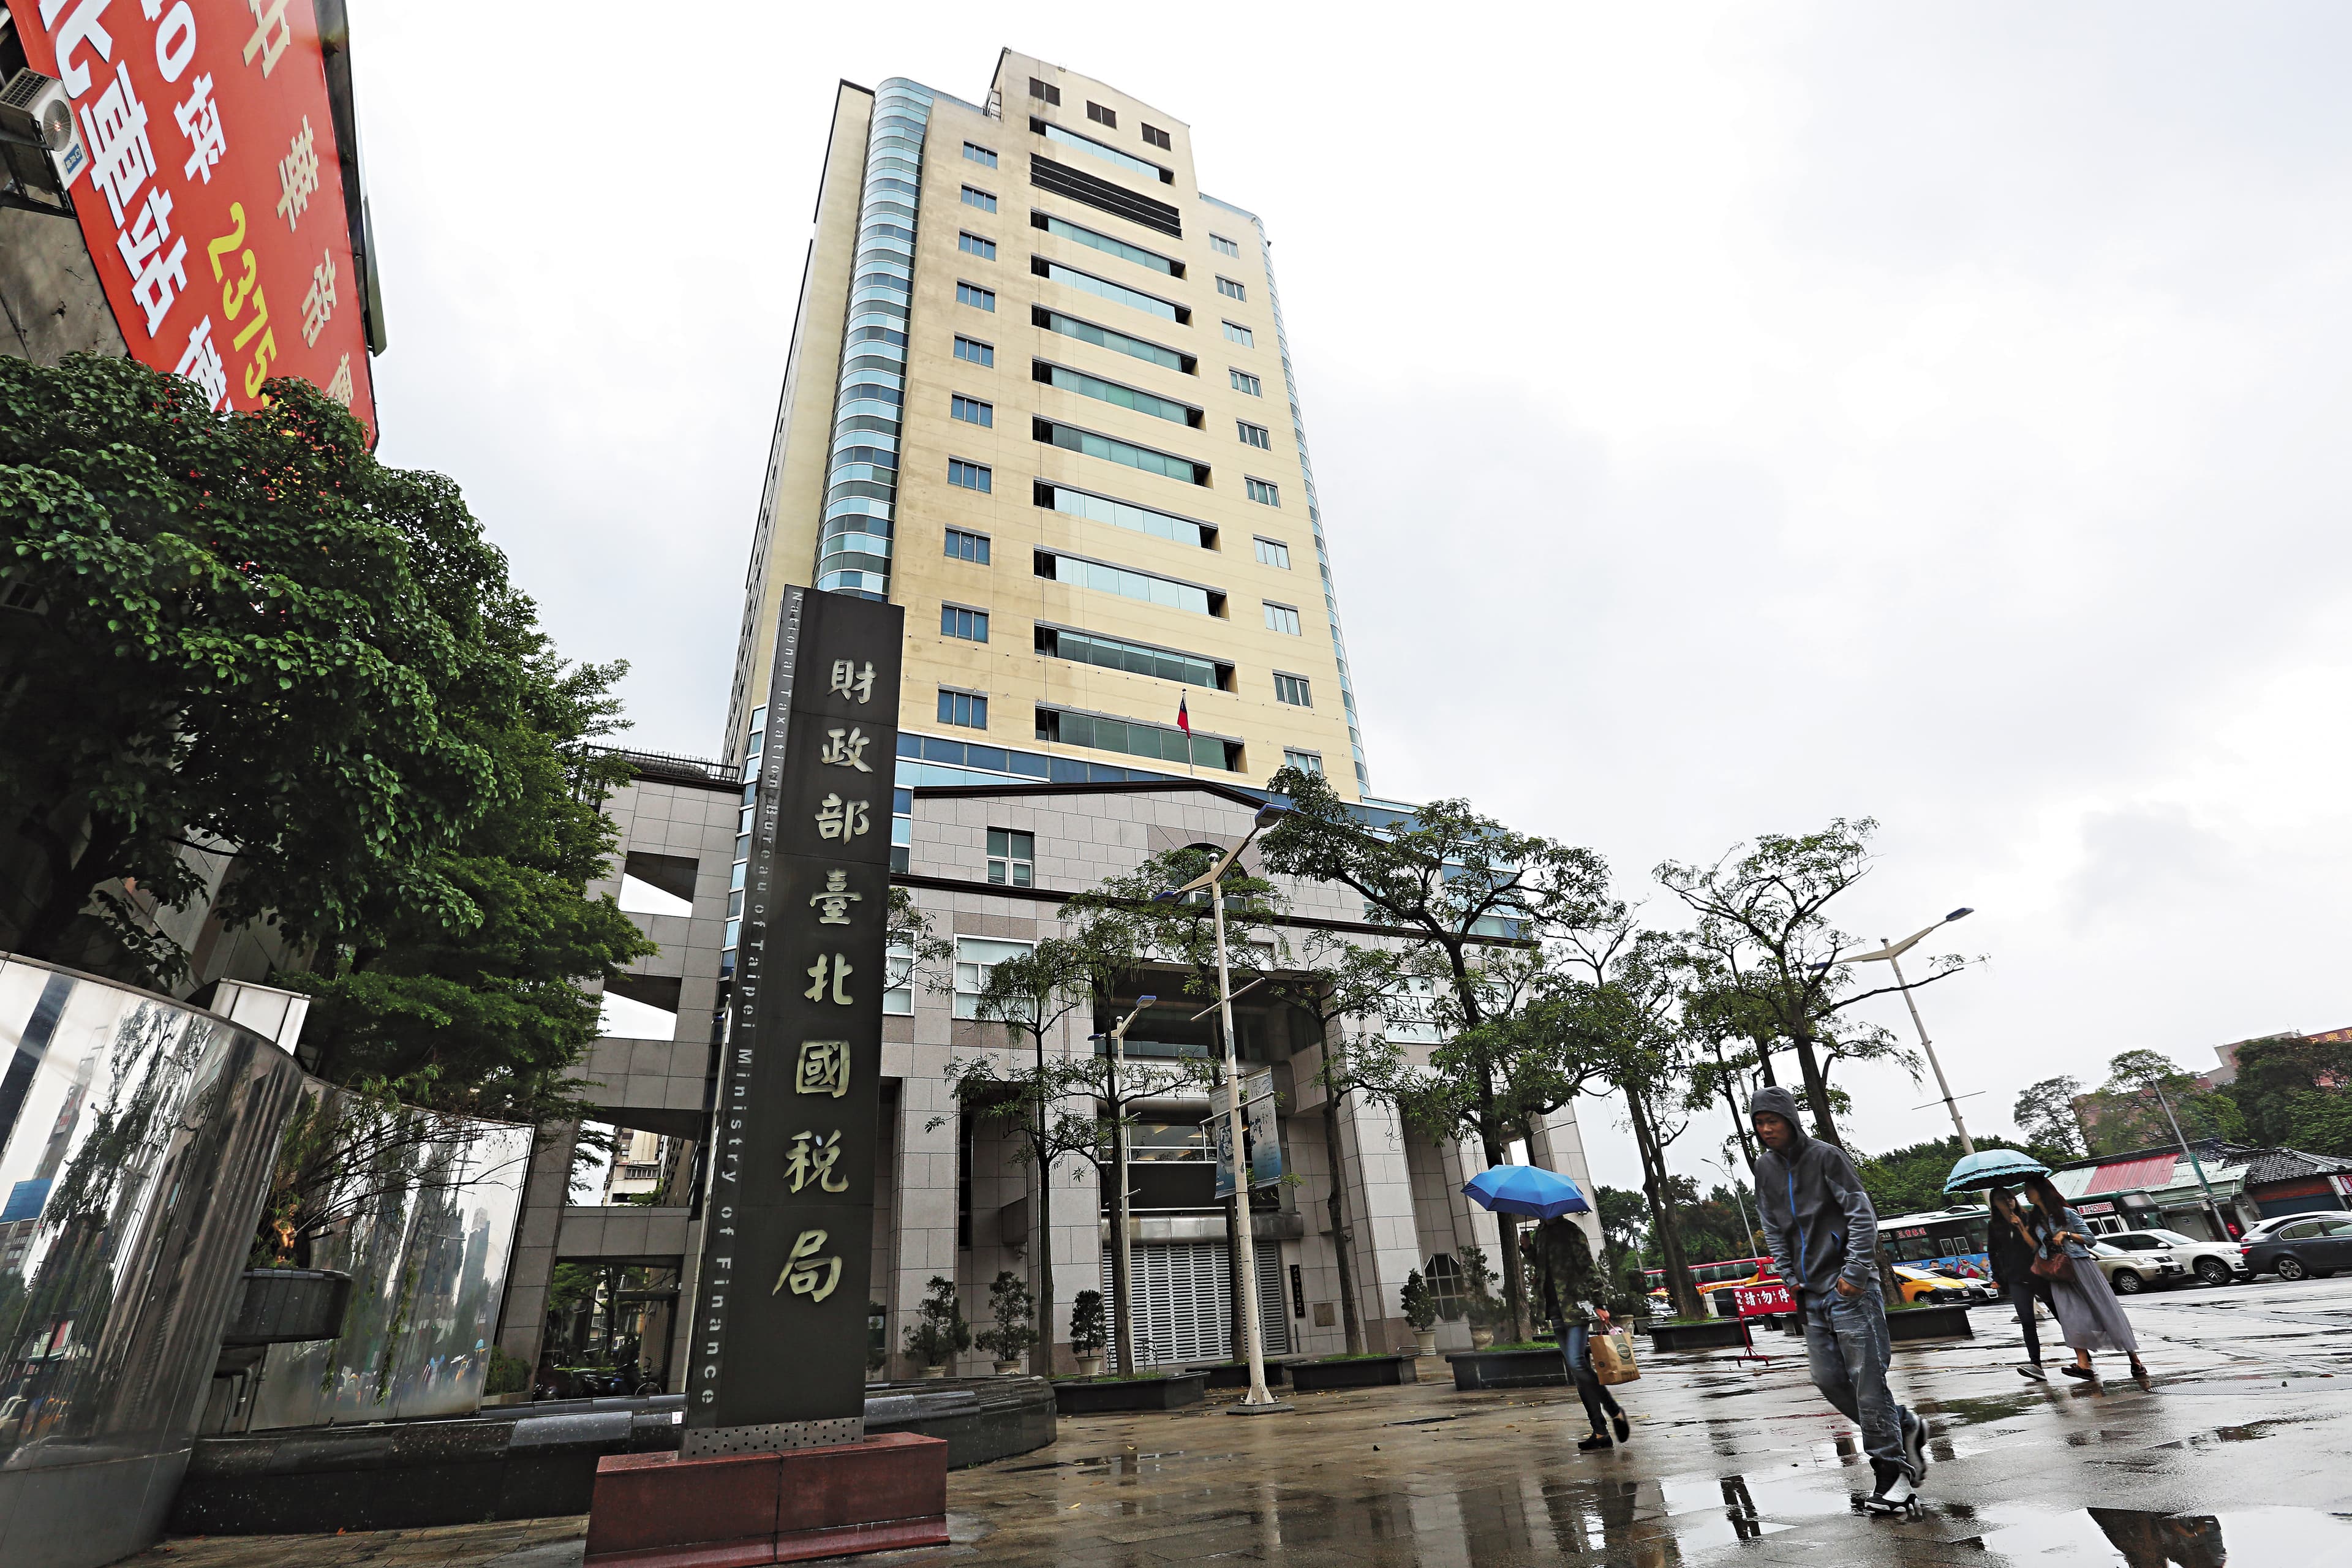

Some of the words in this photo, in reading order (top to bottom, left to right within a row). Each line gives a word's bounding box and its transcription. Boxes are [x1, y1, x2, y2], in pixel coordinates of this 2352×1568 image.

[141, 0, 227, 184] 0坪
[782, 591, 804, 679] National
[769, 689, 793, 788] Taxation
[756, 804, 779, 891] Bureau
[753, 904, 766, 928] of
[741, 940, 764, 1028] Taipei
[721, 1049, 753, 1183] Ministry
[719, 1206, 734, 1236] of
[701, 1257, 732, 1404] Finance
